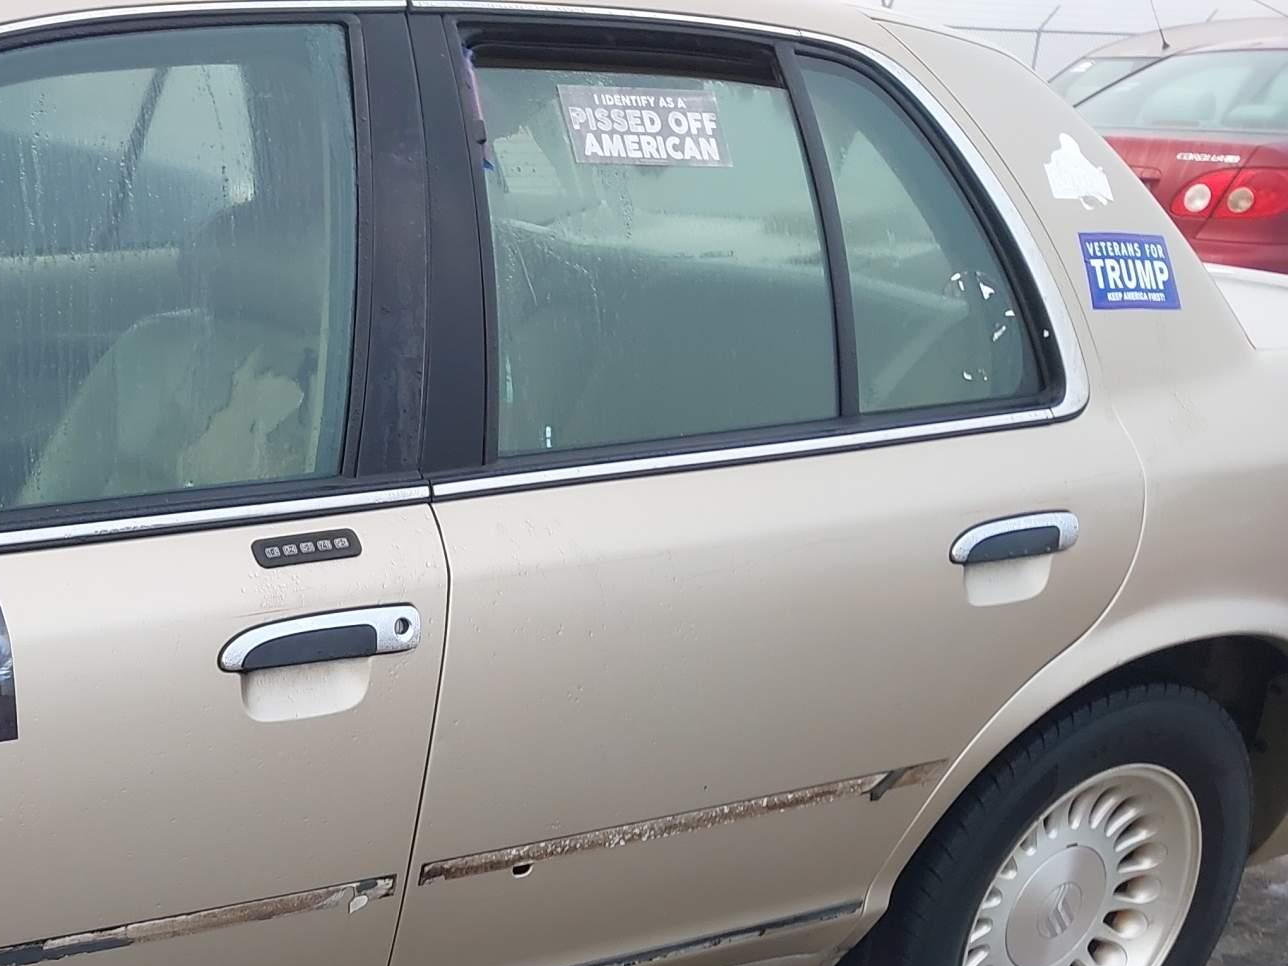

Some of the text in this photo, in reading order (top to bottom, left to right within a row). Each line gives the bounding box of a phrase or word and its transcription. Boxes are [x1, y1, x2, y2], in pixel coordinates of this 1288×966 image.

[593, 94, 688, 109] I IDENTIFY AS A
[568, 106, 718, 135] PISSED OFF
[584, 133, 721, 161] AMERICAN
[1086, 241, 1166, 258] VETERANS FOR
[1089, 258, 1169, 290] TRUMP
